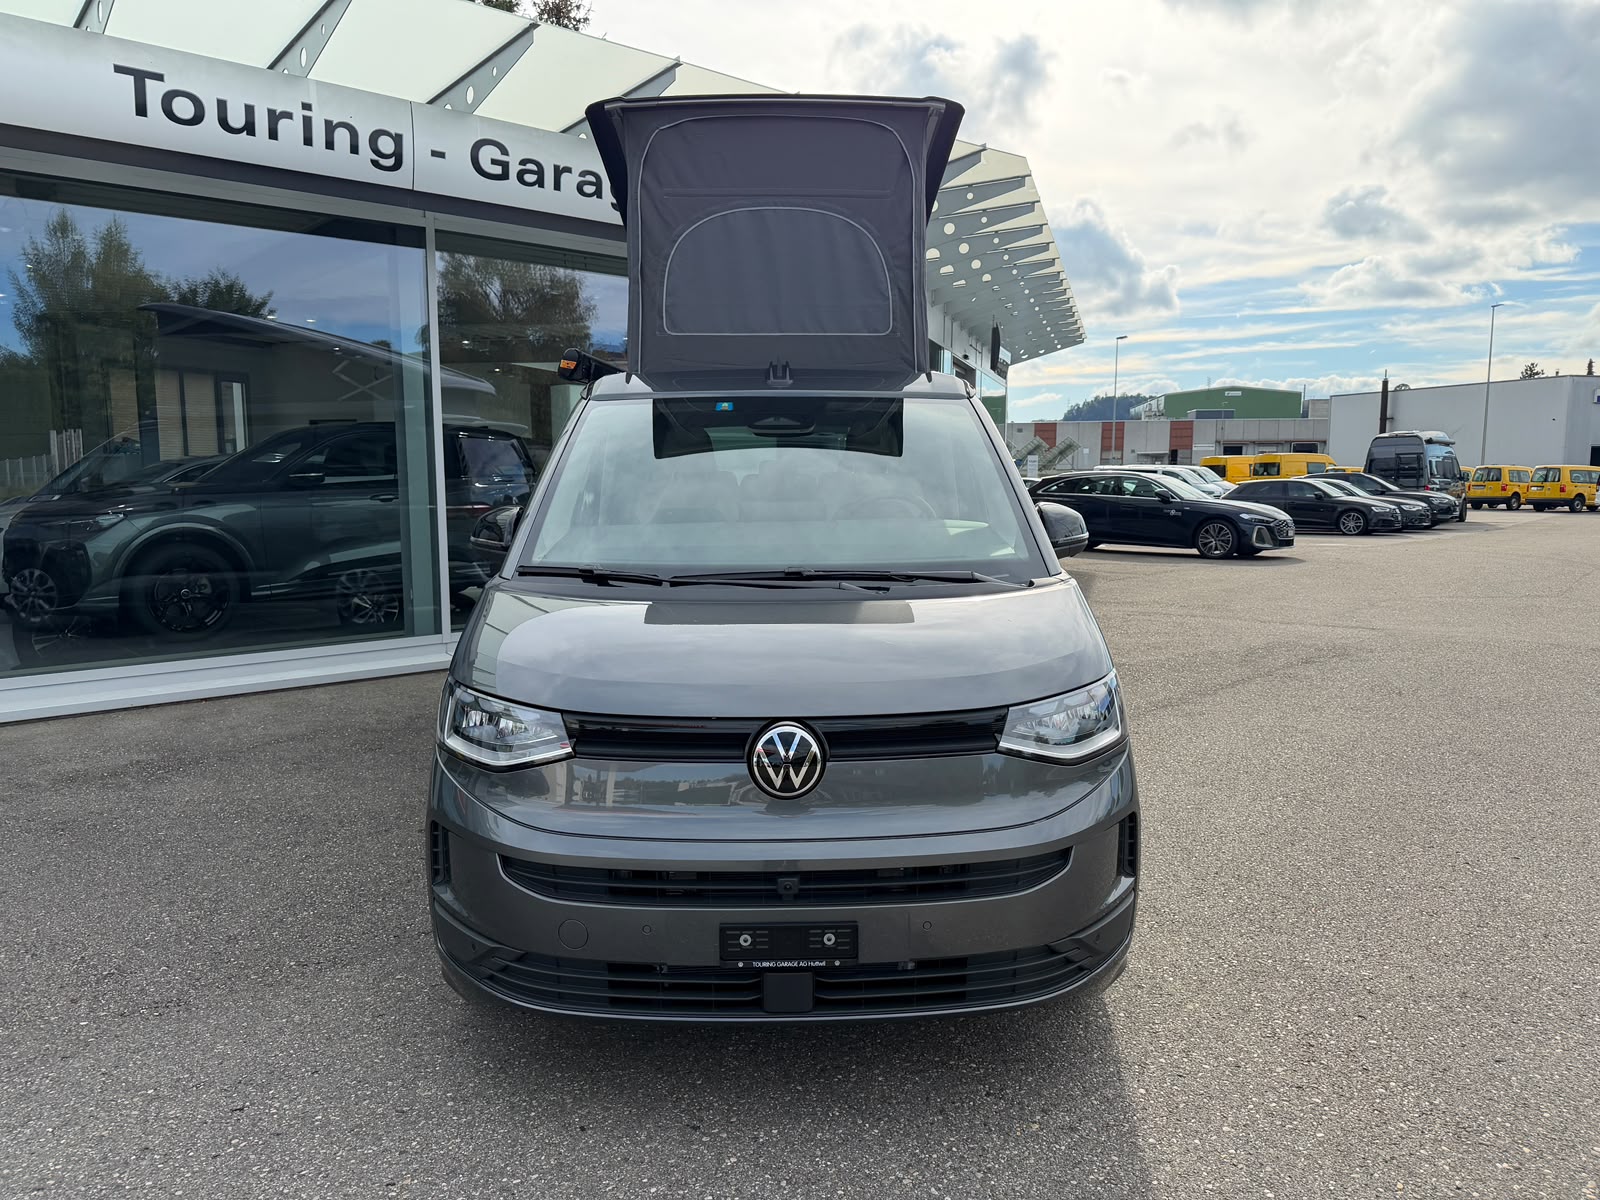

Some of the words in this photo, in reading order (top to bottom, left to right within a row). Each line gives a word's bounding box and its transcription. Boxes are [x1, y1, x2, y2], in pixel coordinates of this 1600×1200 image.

[113, 64, 404, 172] Touring
[470, 138, 620, 212] Gara
[755, 726, 820, 794] VW
